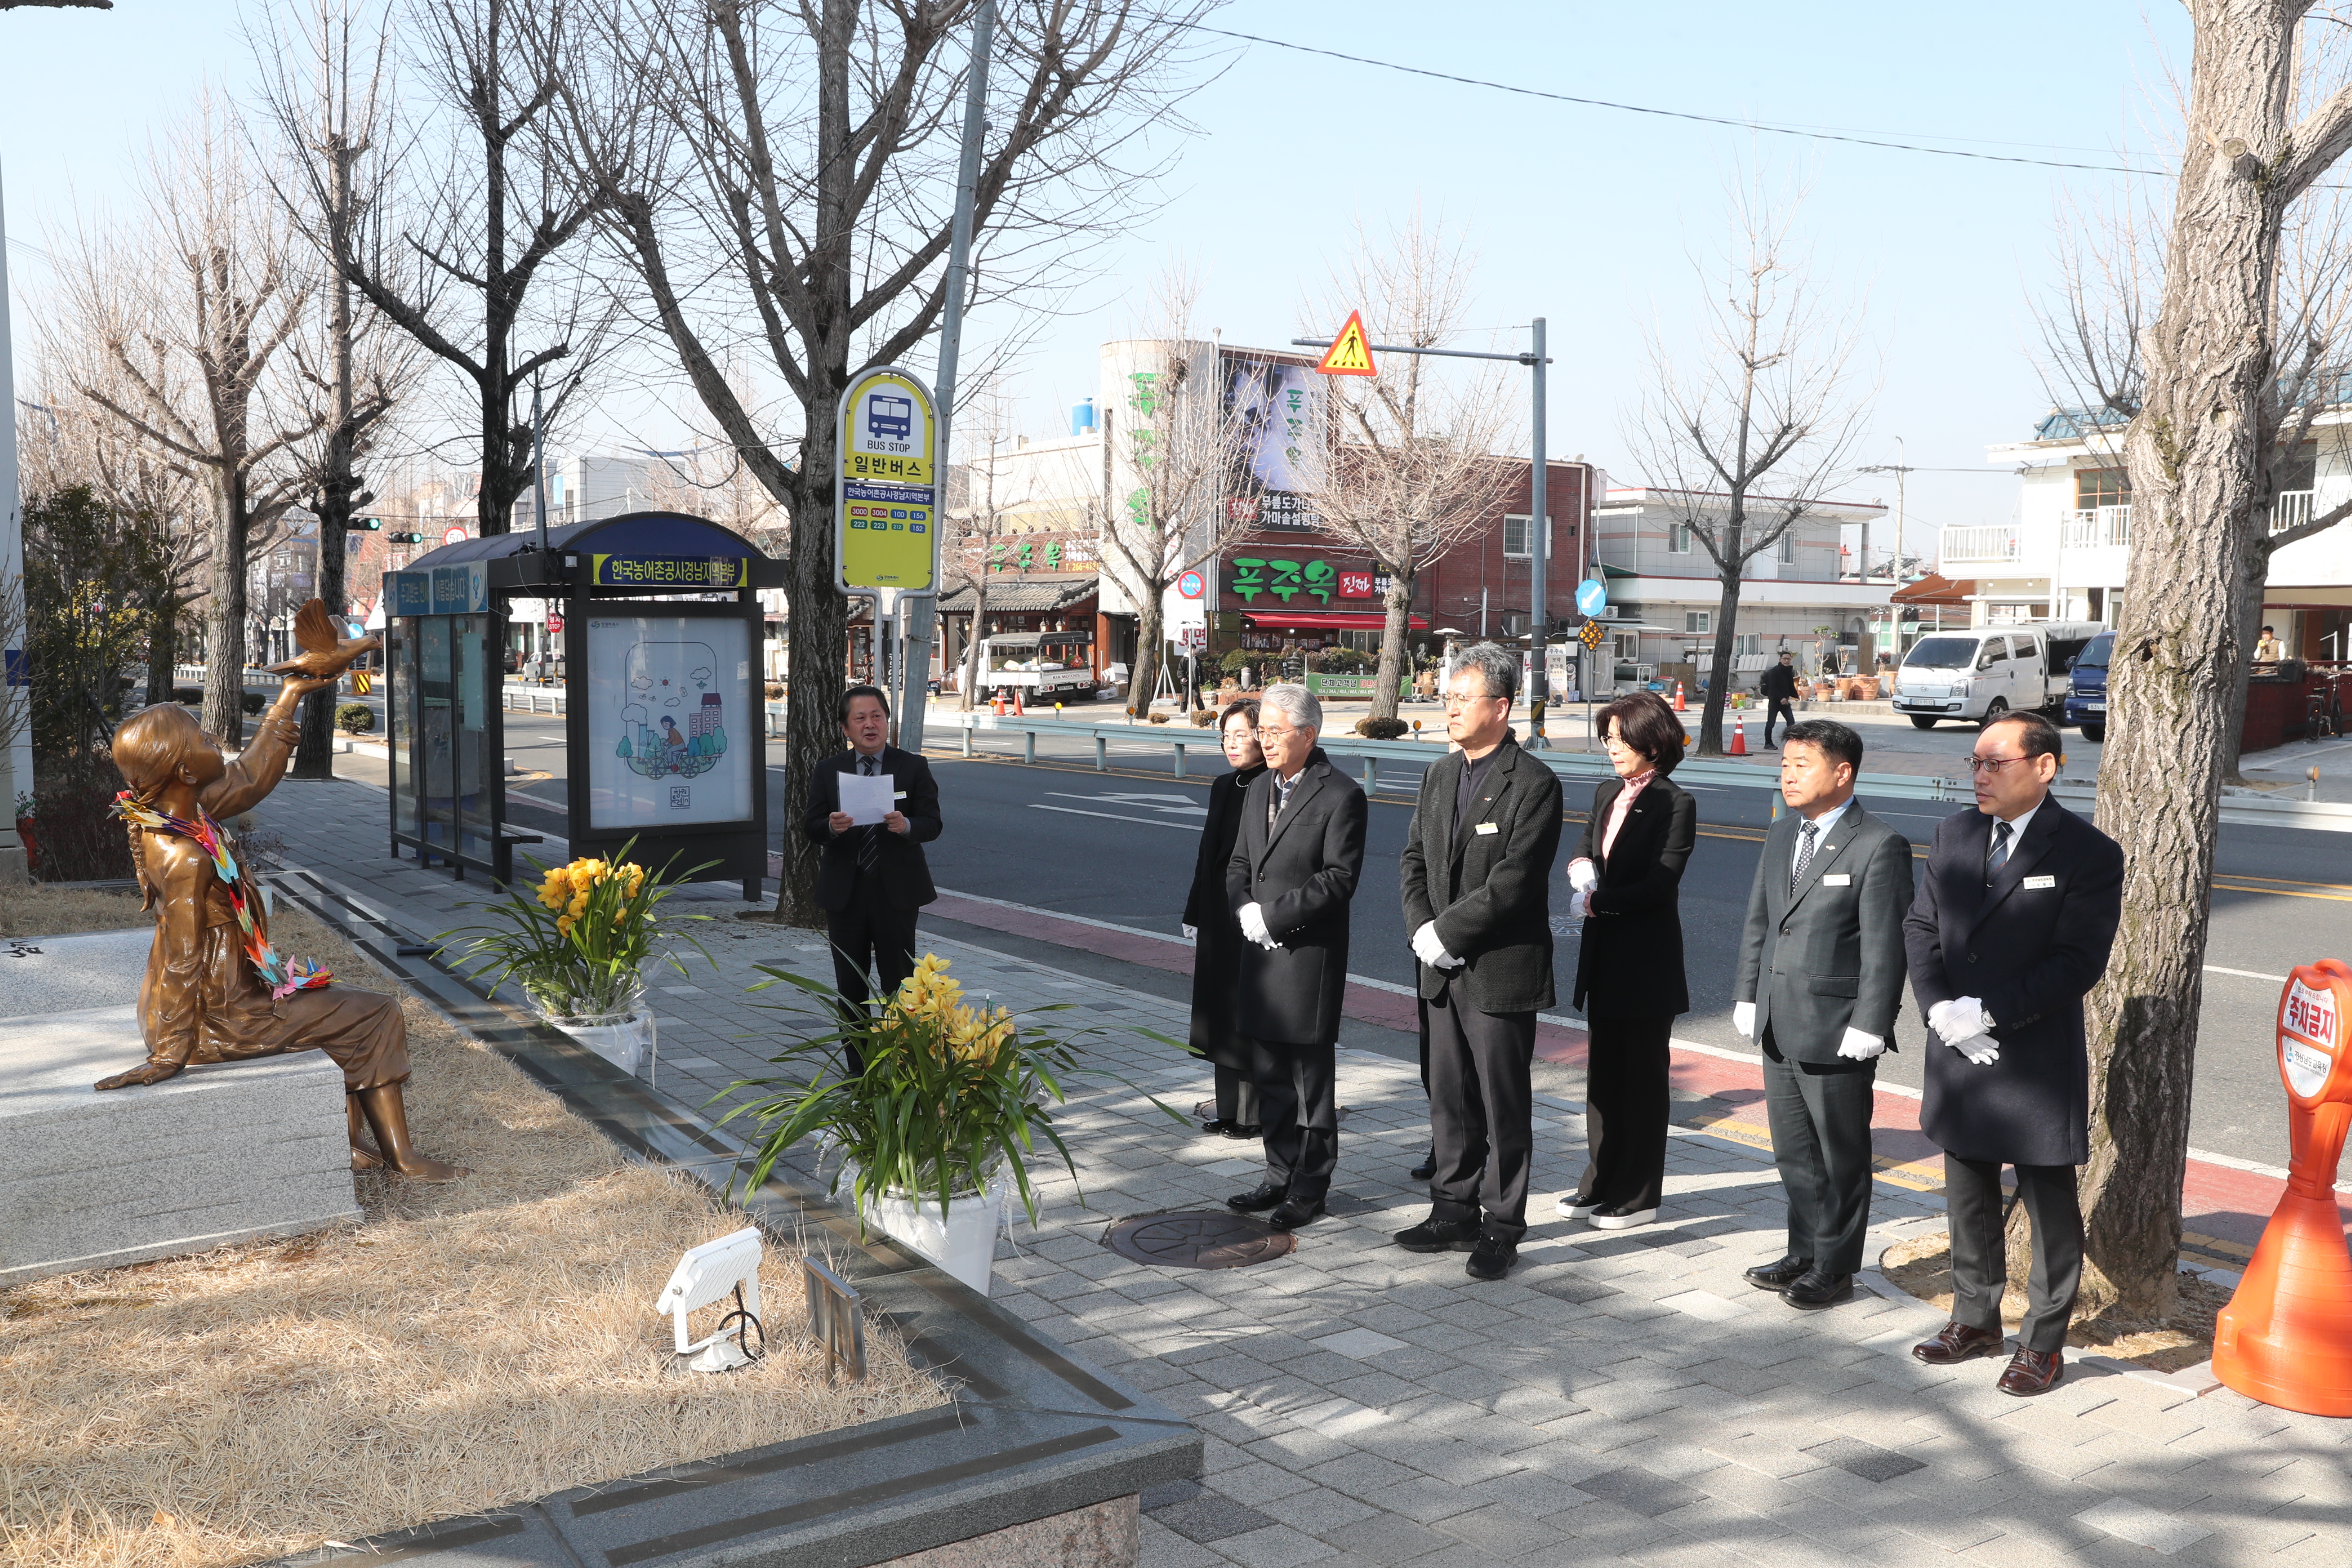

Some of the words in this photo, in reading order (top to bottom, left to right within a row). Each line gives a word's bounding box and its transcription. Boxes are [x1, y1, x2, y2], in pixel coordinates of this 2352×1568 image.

[1286, 389, 1304, 471] 푸주옥
[867, 440, 886, 451] BUS
[888, 441, 910, 453] STOP
[854, 455, 922, 476] 일반버스
[847, 487, 930, 502] 한국농어촌공사경남지역본부
[872, 509, 887, 517] 3004
[449, 534, 462, 544] 50
[612, 560, 735, 582] 한국농어촌공사경남지역본부
[1232, 558, 1337, 605] 푸주옥
[435, 578, 466, 602] 아름답습니다
[1343, 575, 1371, 593] 진짜
[1322, 679, 1357, 688] 단체고객님
[2289, 995, 2335, 1044] 주차금지
[2295, 1050, 2327, 1073] 경상남도교육청
